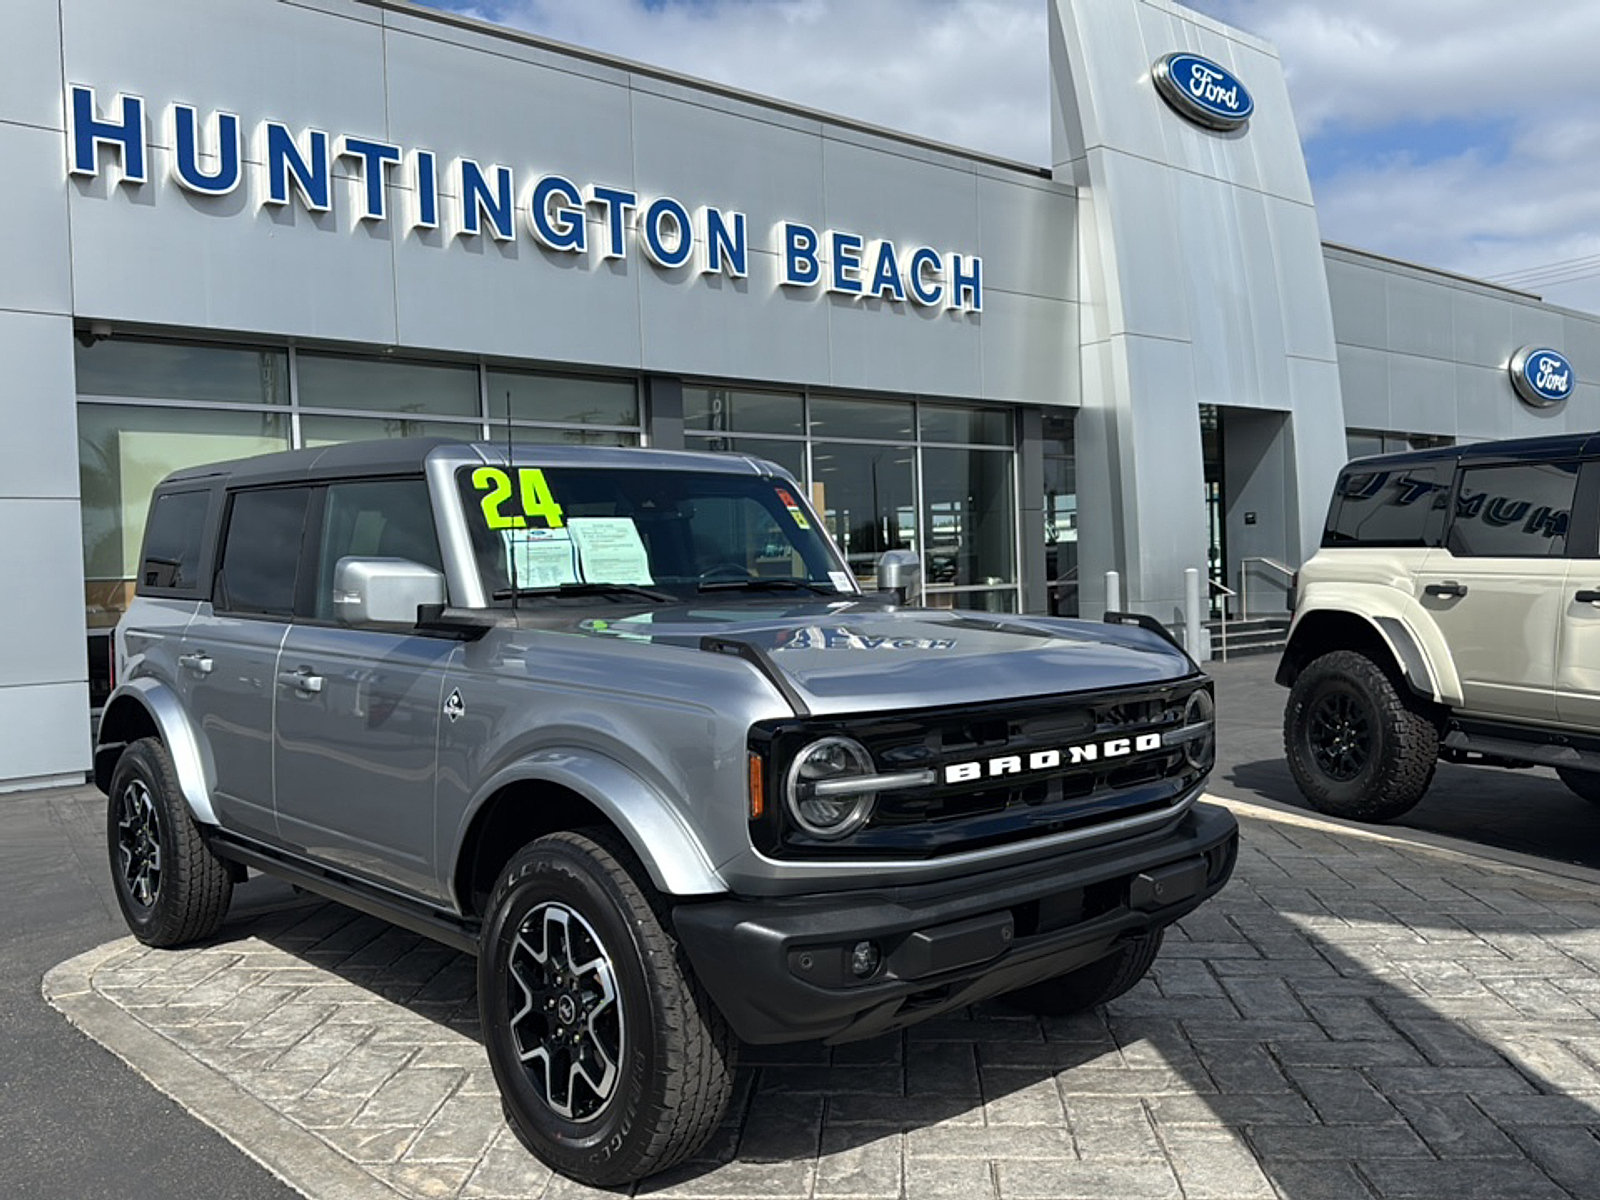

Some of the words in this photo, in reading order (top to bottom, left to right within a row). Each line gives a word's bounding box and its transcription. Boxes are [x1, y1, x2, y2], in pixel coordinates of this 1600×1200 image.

[1189, 63, 1240, 110] Ford
[68, 83, 748, 279] HUNTINGTON
[779, 220, 984, 314] BEACH
[1536, 356, 1569, 392] Ford
[471, 466, 563, 530] 24
[945, 732, 1162, 785] BRONCO
